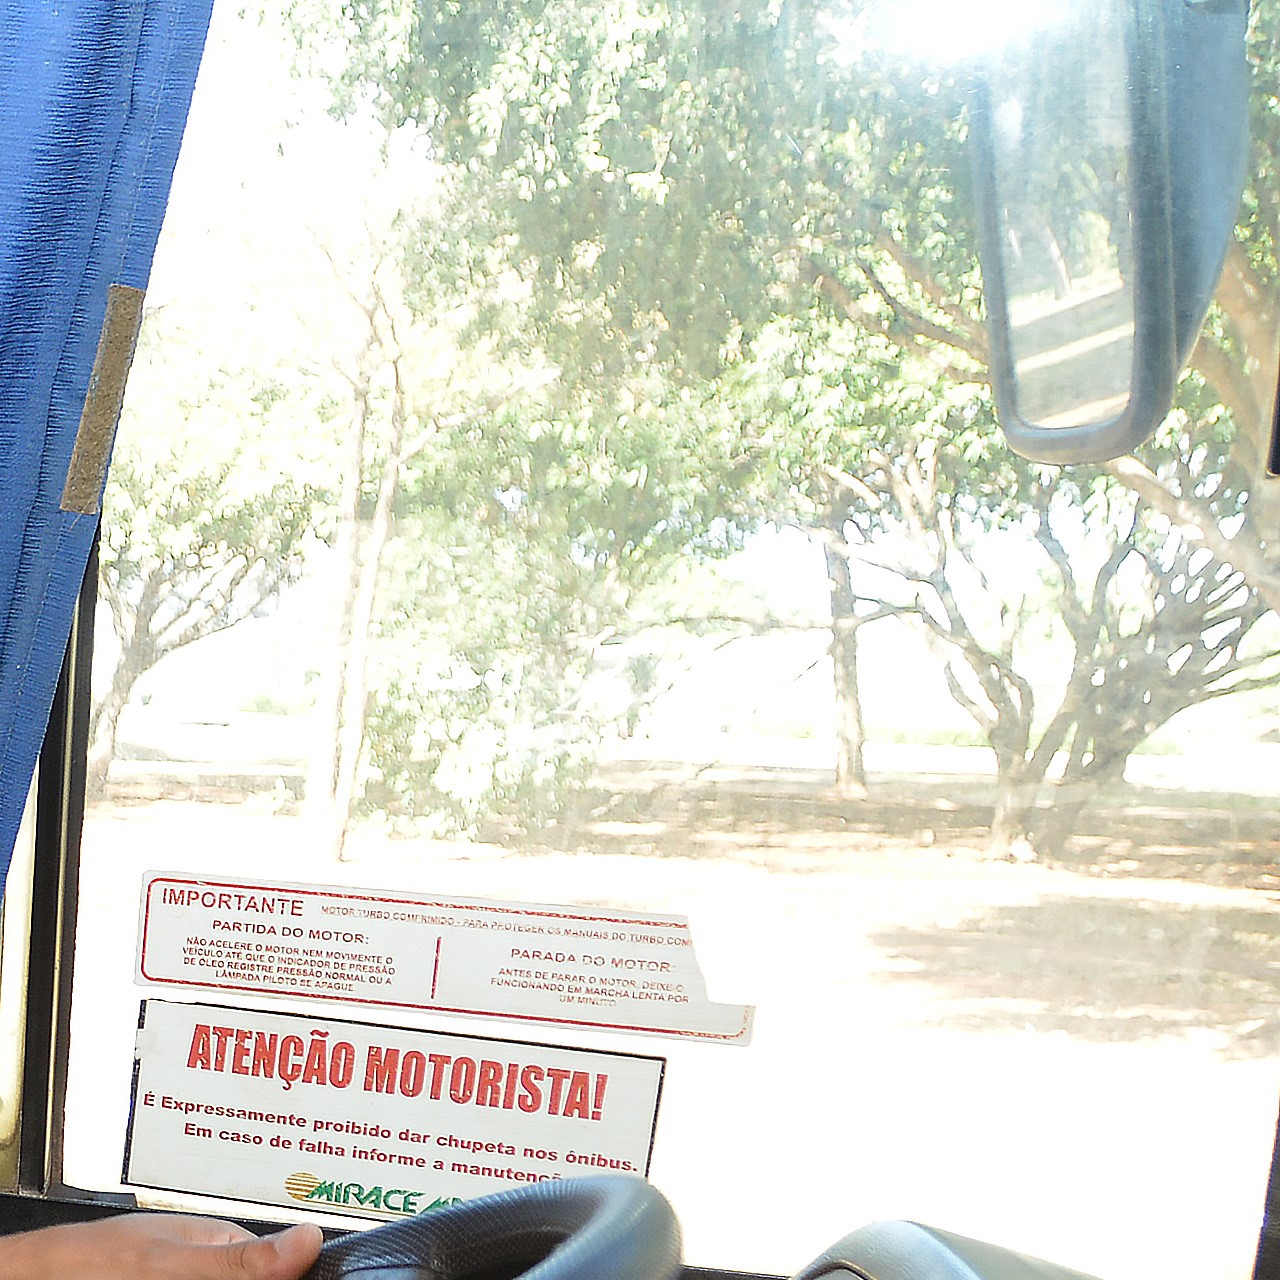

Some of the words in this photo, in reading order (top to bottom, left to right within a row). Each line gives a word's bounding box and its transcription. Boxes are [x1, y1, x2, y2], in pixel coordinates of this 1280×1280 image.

[162, 888, 304, 916] IMPORTANTE
[322, 906, 354, 915] MOTOR
[359, 909, 390, 919] TURBO
[463, 919, 488, 928] PARA
[612, 933, 626, 941] DO
[629, 934, 663, 944] TURBO
[213, 921, 276, 936] PARTIDA
[282, 926, 303, 938] DO
[309, 930, 369, 945] MOTOR:
[183, 946, 223, 957] VEÍCULO
[225, 952, 242, 960] ATÉ
[246, 954, 265, 962] QUE
[278, 957, 330, 968] INDICADOR
[334, 962, 346, 970] DE
[349, 964, 395, 975] PRESSÃO
[187, 937, 207, 946] NÃO
[209, 940, 252, 950] ACELERE
[266, 945, 299, 954] MOTOR
[302, 949, 323, 957] NEM
[326, 951, 382, 963] MOVIMENTE
[511, 949, 576, 962] PARADA
[583, 955, 605, 966] DO
[184, 957, 196, 965] DE
[227, 962, 274, 973] REGISTRE
[277, 967, 322, 978] PRESSÃO
[325, 972, 365, 982] NORMAL
[369, 976, 382, 984] OU
[216, 970, 260, 982] LÂMPADA
[263, 975, 297, 985] PILOTO
[498, 968, 532, 978] ANTES
[535, 971, 548, 980] DE
[552, 973, 585, 983] PARAR
[491, 978, 564, 992] FUNCIONANDO
[568, 985, 582, 993] EM
[585, 987, 629, 998] MARCHA
[632, 992, 665, 1001] LENTA
[667, 994, 689, 1003] POR
[560, 995, 575, 1003] UM
[186, 1024, 355, 1090] ATENÇÃO
[364, 1046, 608, 1121] MOTORISTA!
[144, 1091, 155, 1106] É
[161, 1096, 307, 1127] Expressamente
[313, 1119, 391, 1140] proibido
[399, 1128, 430, 1144] dar
[436, 1135, 516, 1155] chupeta
[523, 1147, 557, 1161] nos
[565, 1151, 638, 1172] ônibus.
[184, 1123, 212, 1138] Em
[219, 1129, 263, 1145] caso
[270, 1135, 292, 1149] de
[299, 1139, 345, 1157] falha
[352, 1146, 425, 1168] informe
[433, 1158, 444, 1171] a
